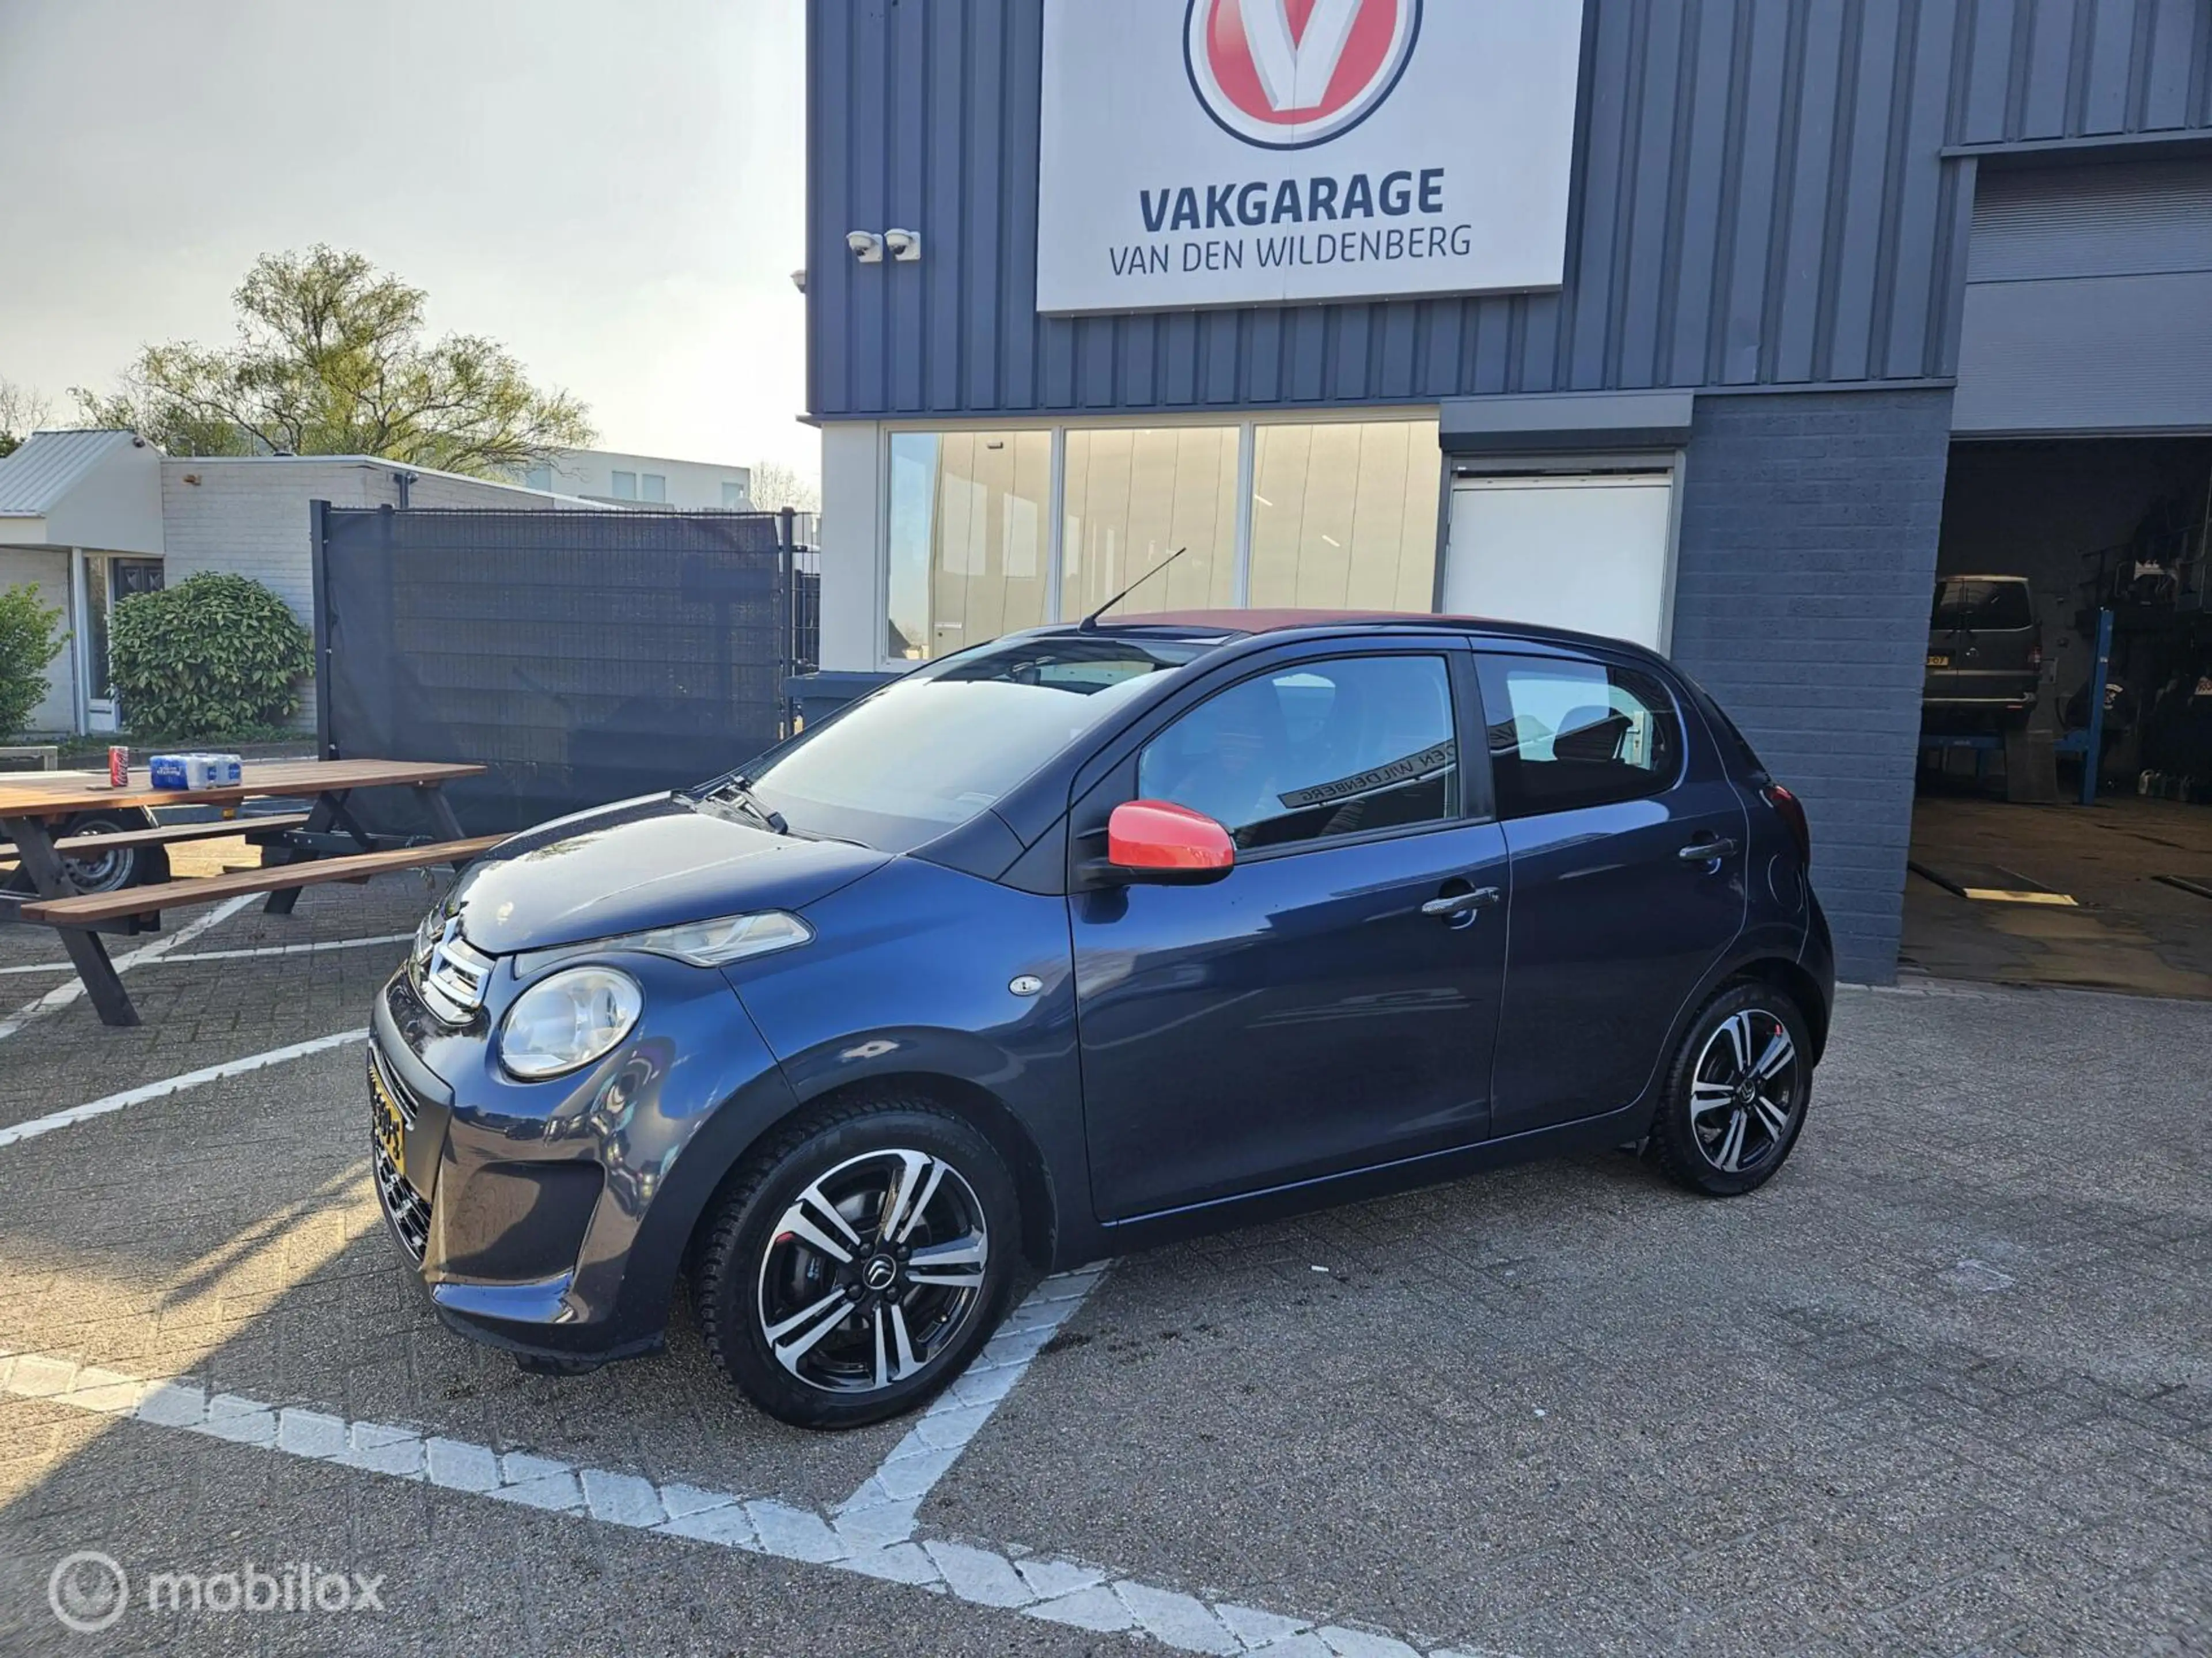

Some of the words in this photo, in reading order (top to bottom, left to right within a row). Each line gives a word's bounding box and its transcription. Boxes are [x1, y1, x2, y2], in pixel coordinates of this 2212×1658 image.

[1140, 168, 1445, 233] VAKGARAGE
[1109, 244, 1169, 276] VAN
[1183, 240, 1243, 272] DEN
[1257, 225, 1472, 268] WILDENBERG
